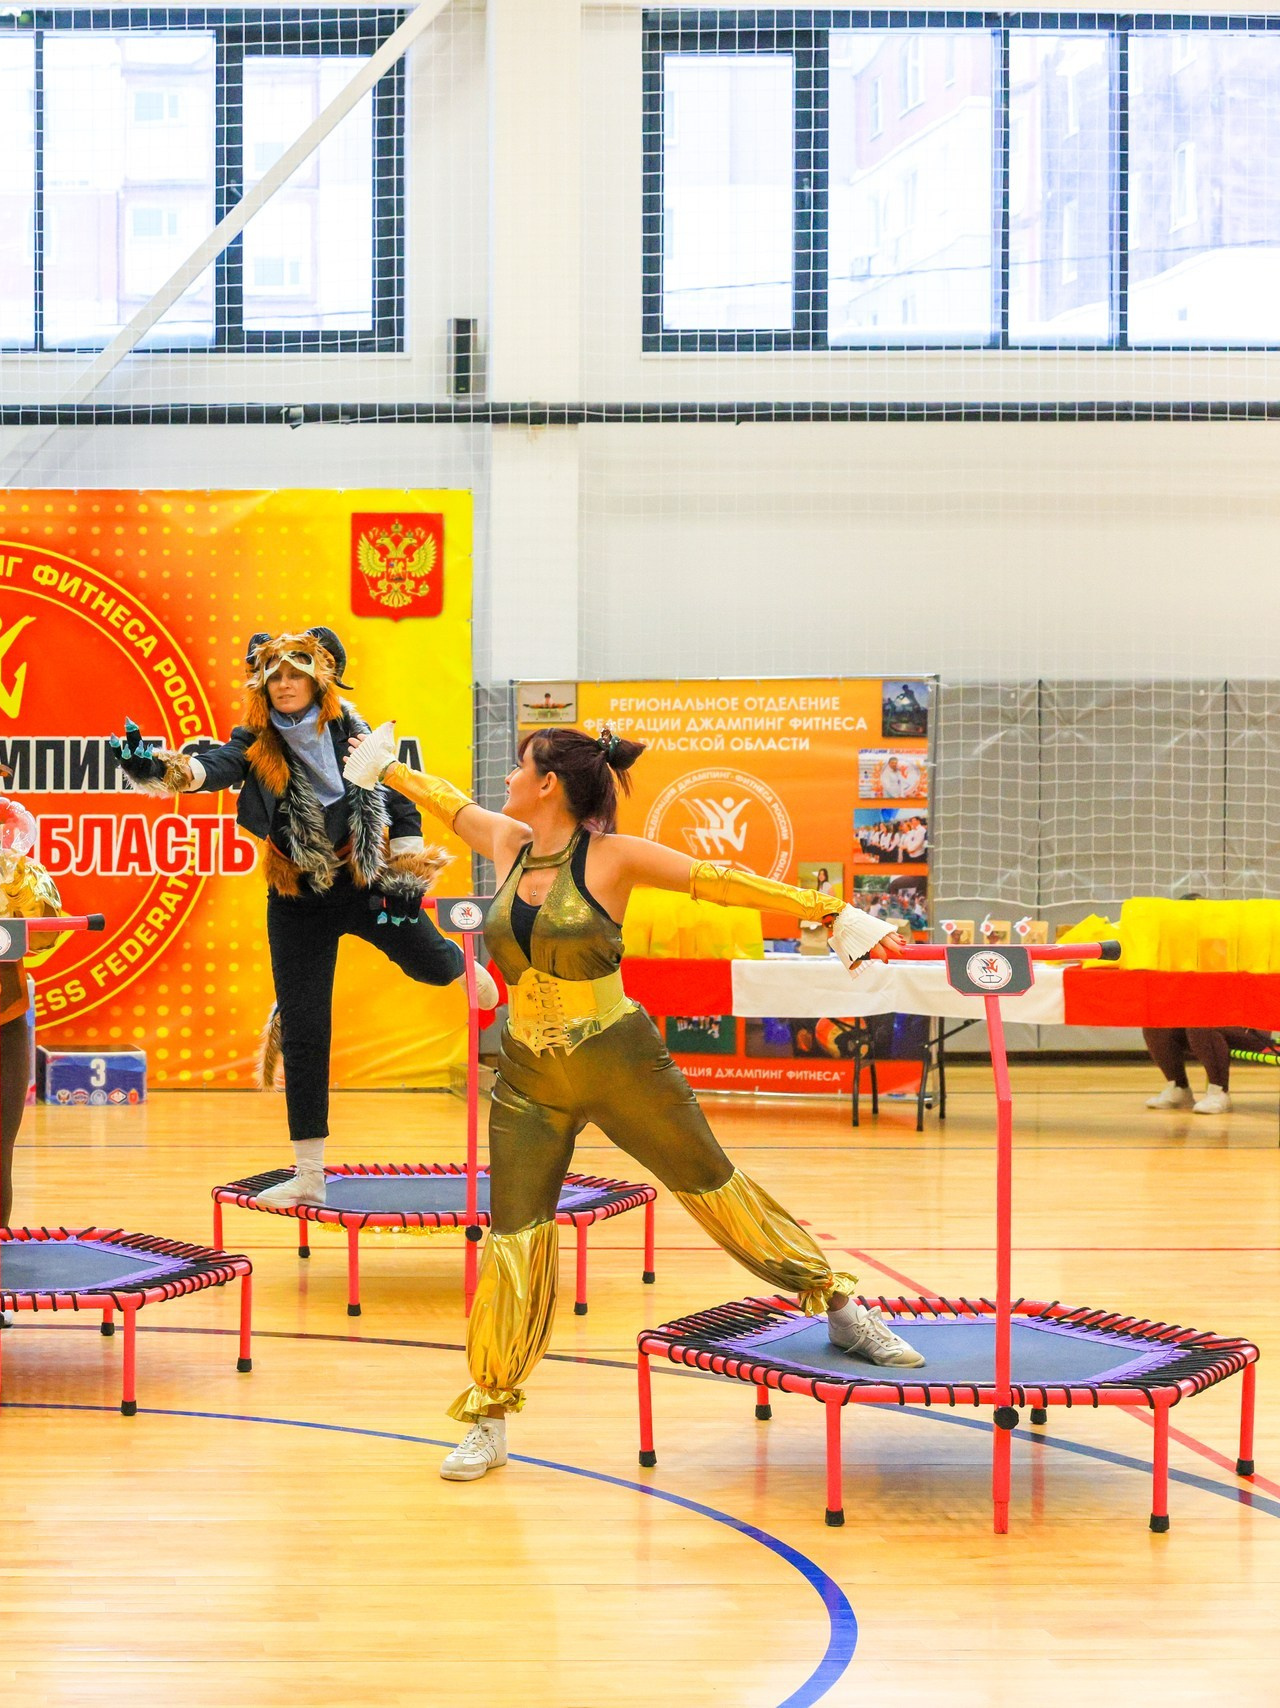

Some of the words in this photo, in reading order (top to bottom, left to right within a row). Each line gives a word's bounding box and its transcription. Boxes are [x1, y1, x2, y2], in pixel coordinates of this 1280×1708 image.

[31, 564, 159, 659] ФИТНЕСА
[152, 656, 205, 743] РОСС
[610, 696, 739, 711] РЕГИОНАЛЬНОЕ
[744, 696, 840, 711] ОТДЕЛЕНИЕ
[685, 717, 785, 732] ДЖАМПИНГ
[789, 717, 868, 731] ФИТНЕСА
[730, 737, 810, 751] ОБЛАСТИ
[734, 774, 773, 804] ФИТНЕСА
[770, 802, 790, 841] РОССИИ
[3, 817, 255, 874] БЛАСТЬ
[90, 1058, 106, 1087] 3
[715, 1068, 782, 1080] ДЖАМПИНГ
[786, 1070, 846, 1081] ФИТНЕСА"
